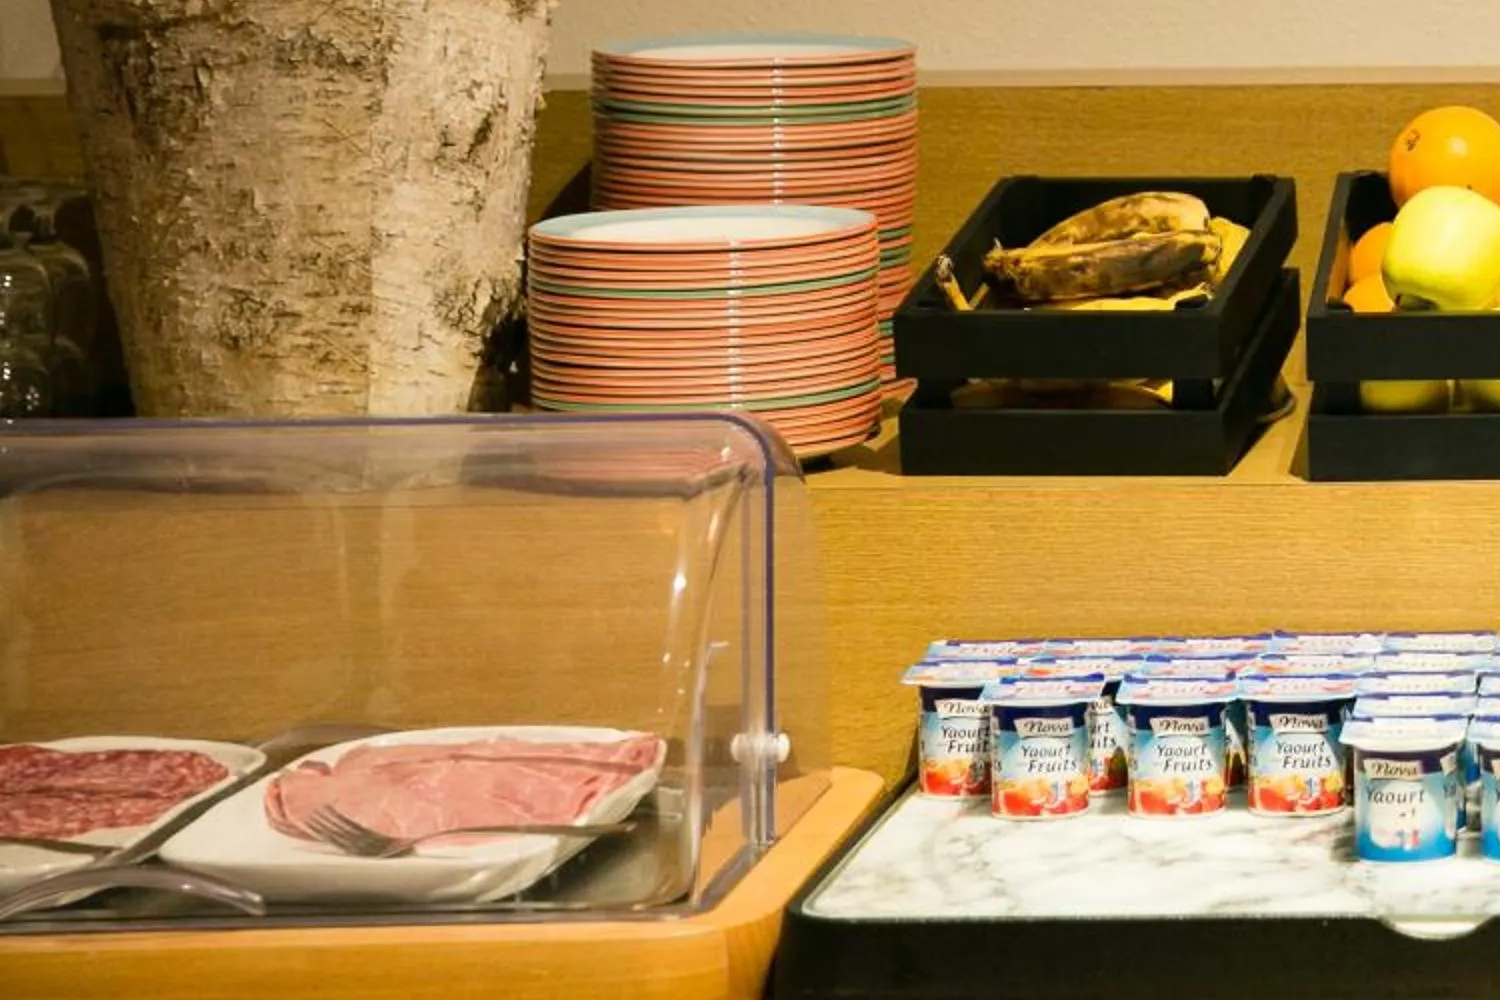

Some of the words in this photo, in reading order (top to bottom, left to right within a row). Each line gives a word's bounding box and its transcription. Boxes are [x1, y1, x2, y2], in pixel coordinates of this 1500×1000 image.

[947, 740, 990, 753] Fruit
[1022, 744, 1071, 758] Yaourt
[1157, 744, 1207, 757] Yaourt
[1276, 741, 1325, 756] Yaourt
[1027, 759, 1077, 773] Fruits
[1163, 759, 1213, 773] Fruits
[1282, 756, 1332, 769] Fruits
[1365, 783, 1425, 804] Yaourt
